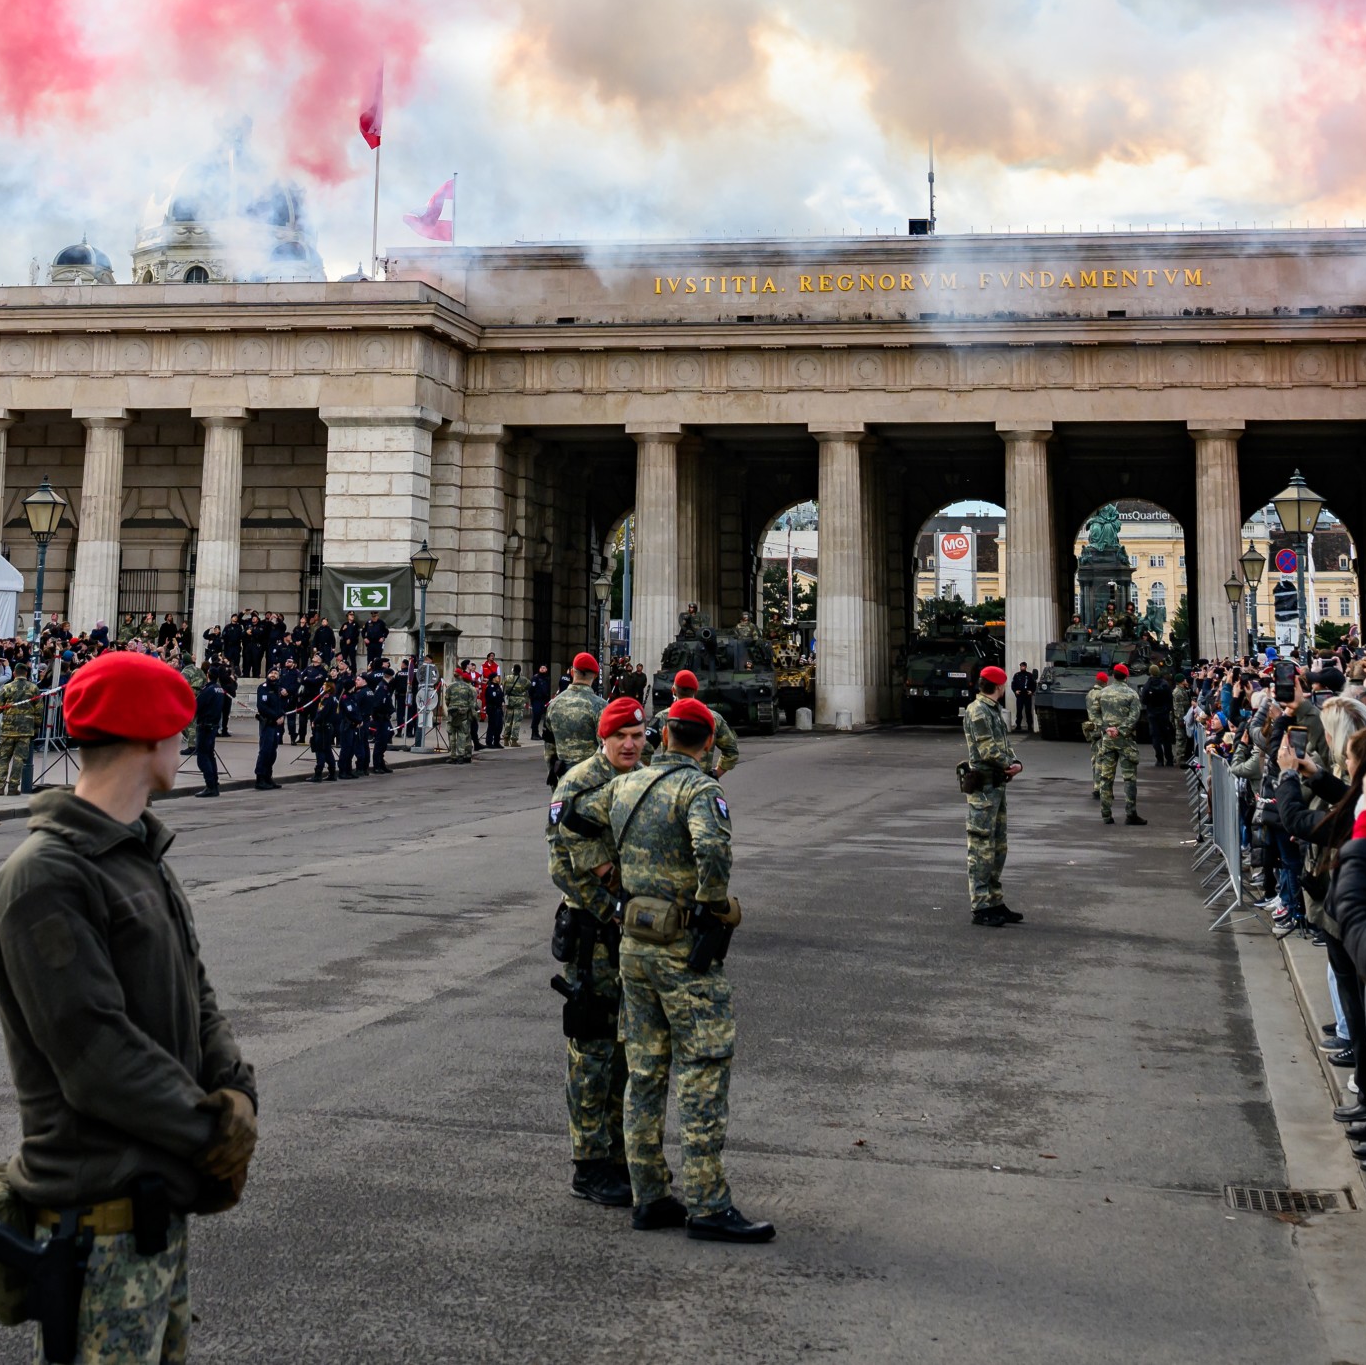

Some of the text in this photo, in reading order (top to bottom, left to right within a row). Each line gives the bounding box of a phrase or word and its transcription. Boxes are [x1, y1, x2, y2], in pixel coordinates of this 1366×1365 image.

[654, 269, 1212, 294] IVSTITIA. REGNORVM. FVNDAMENTVM.
[943, 537, 968, 551] MQ
